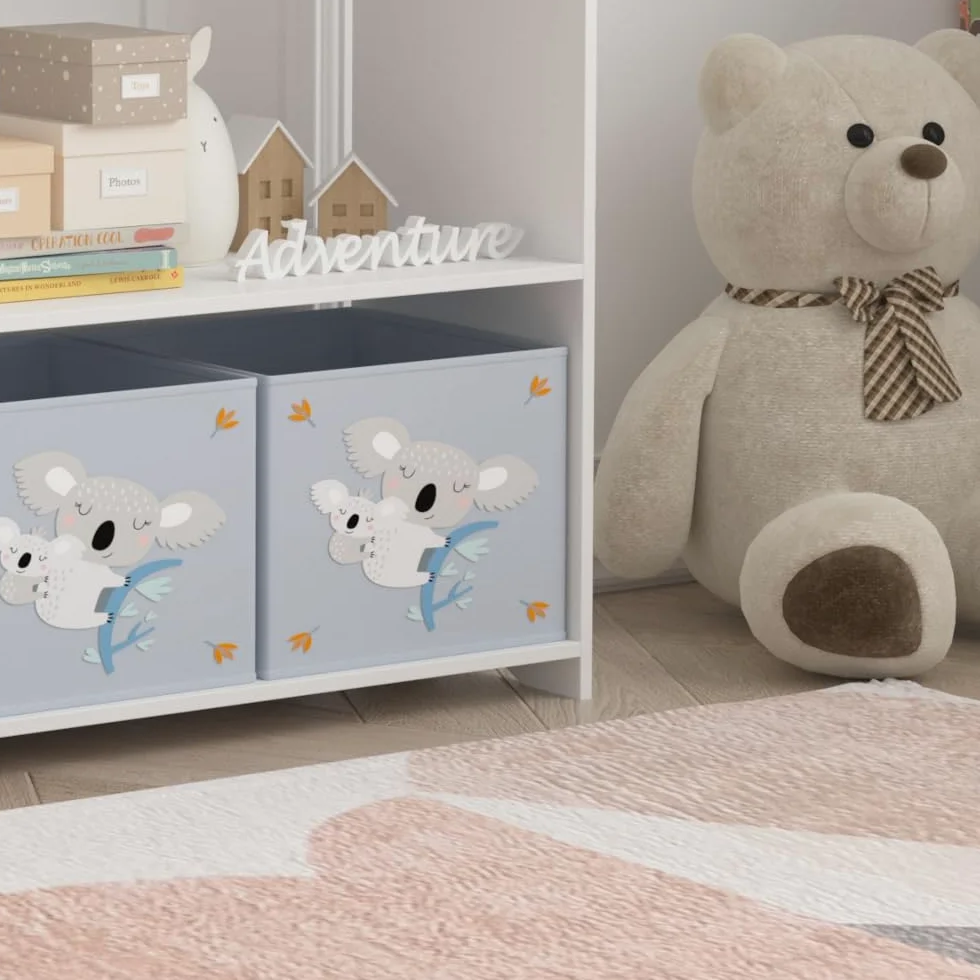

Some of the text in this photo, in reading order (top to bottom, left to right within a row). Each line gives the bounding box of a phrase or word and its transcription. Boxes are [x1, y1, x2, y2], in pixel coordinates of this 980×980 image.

[109, 176, 141, 188] Photos
[234, 215, 525, 282] Adventure
[25, 283, 33, 291] IN
[34, 279, 82, 290] WONDERLAND
